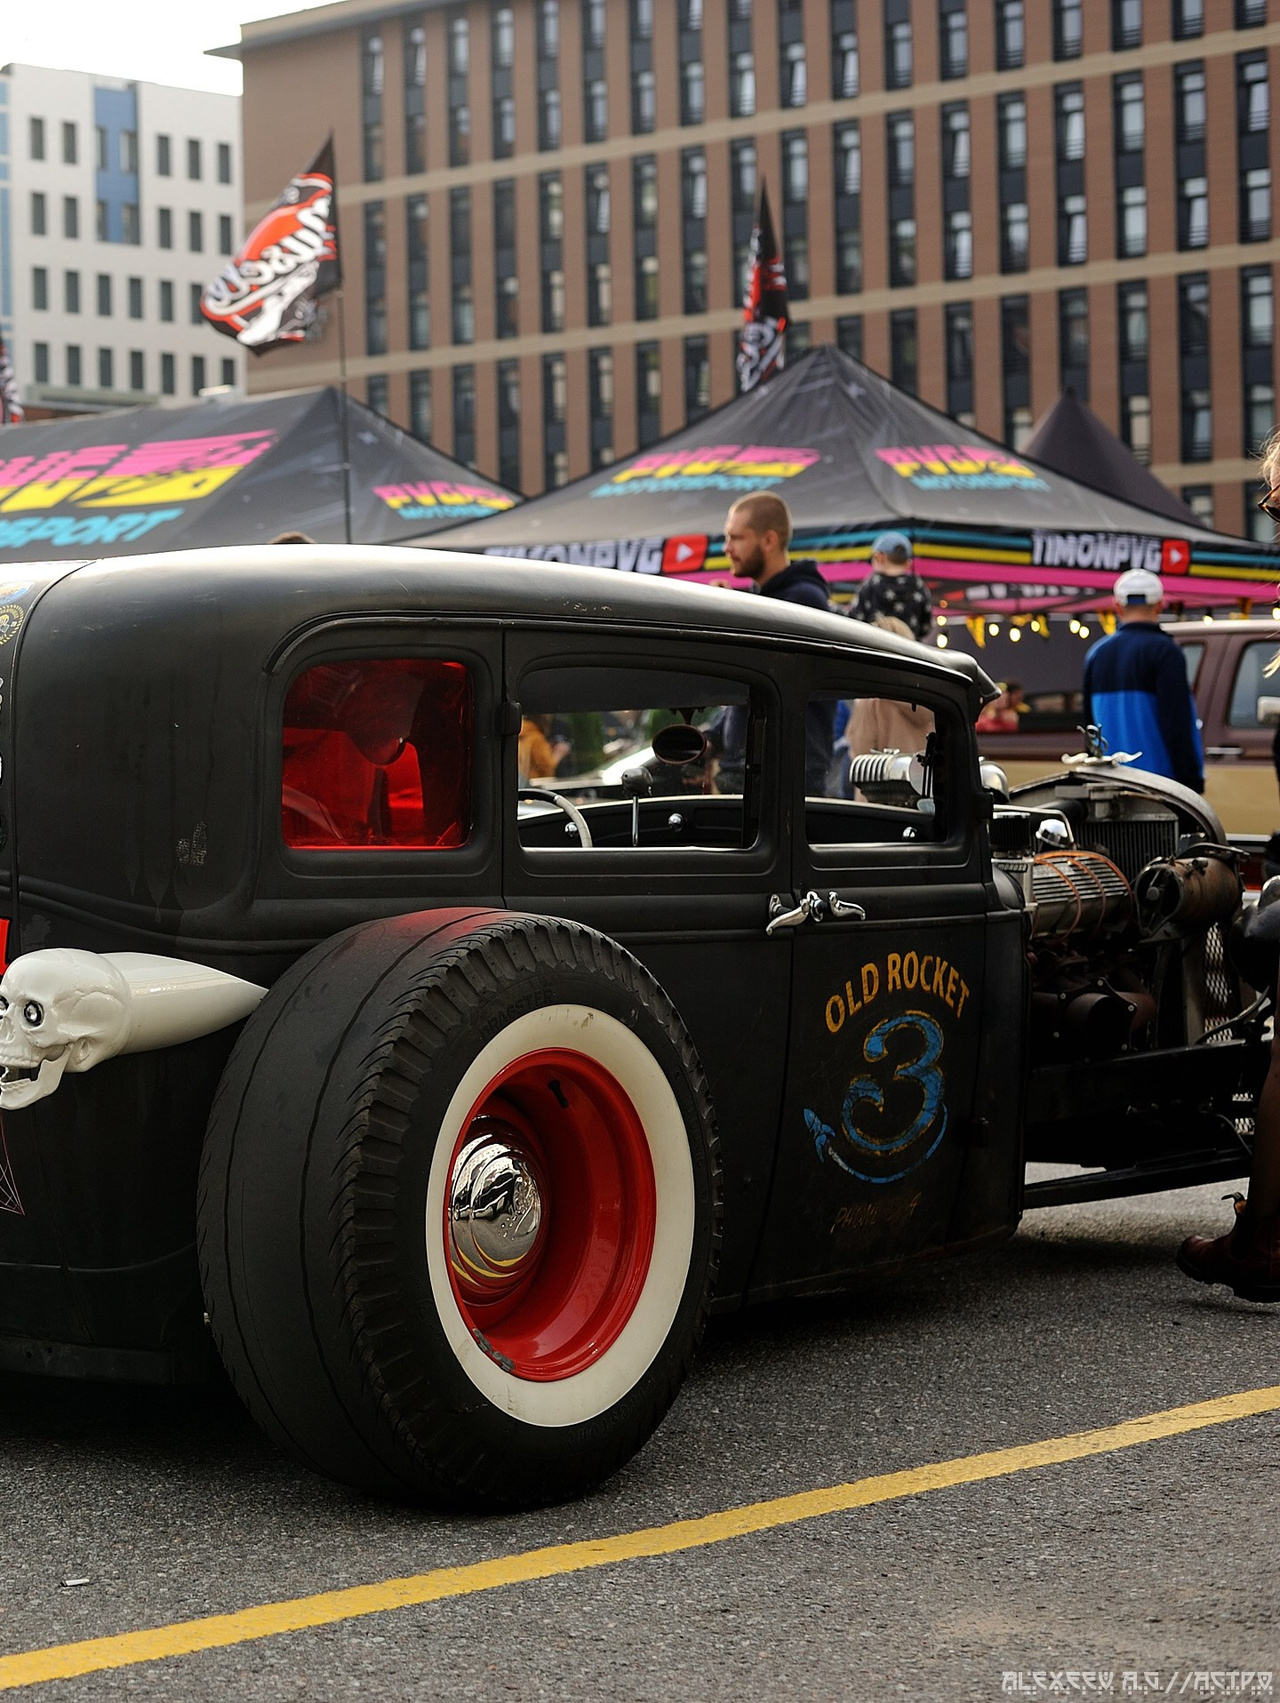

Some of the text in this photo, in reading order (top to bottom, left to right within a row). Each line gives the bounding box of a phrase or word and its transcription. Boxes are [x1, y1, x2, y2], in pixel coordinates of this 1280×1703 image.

[1031, 530, 1162, 574] TIMONPVG
[825, 950, 970, 1033] OLD ROCKET
[841, 1009, 945, 1157] 3
